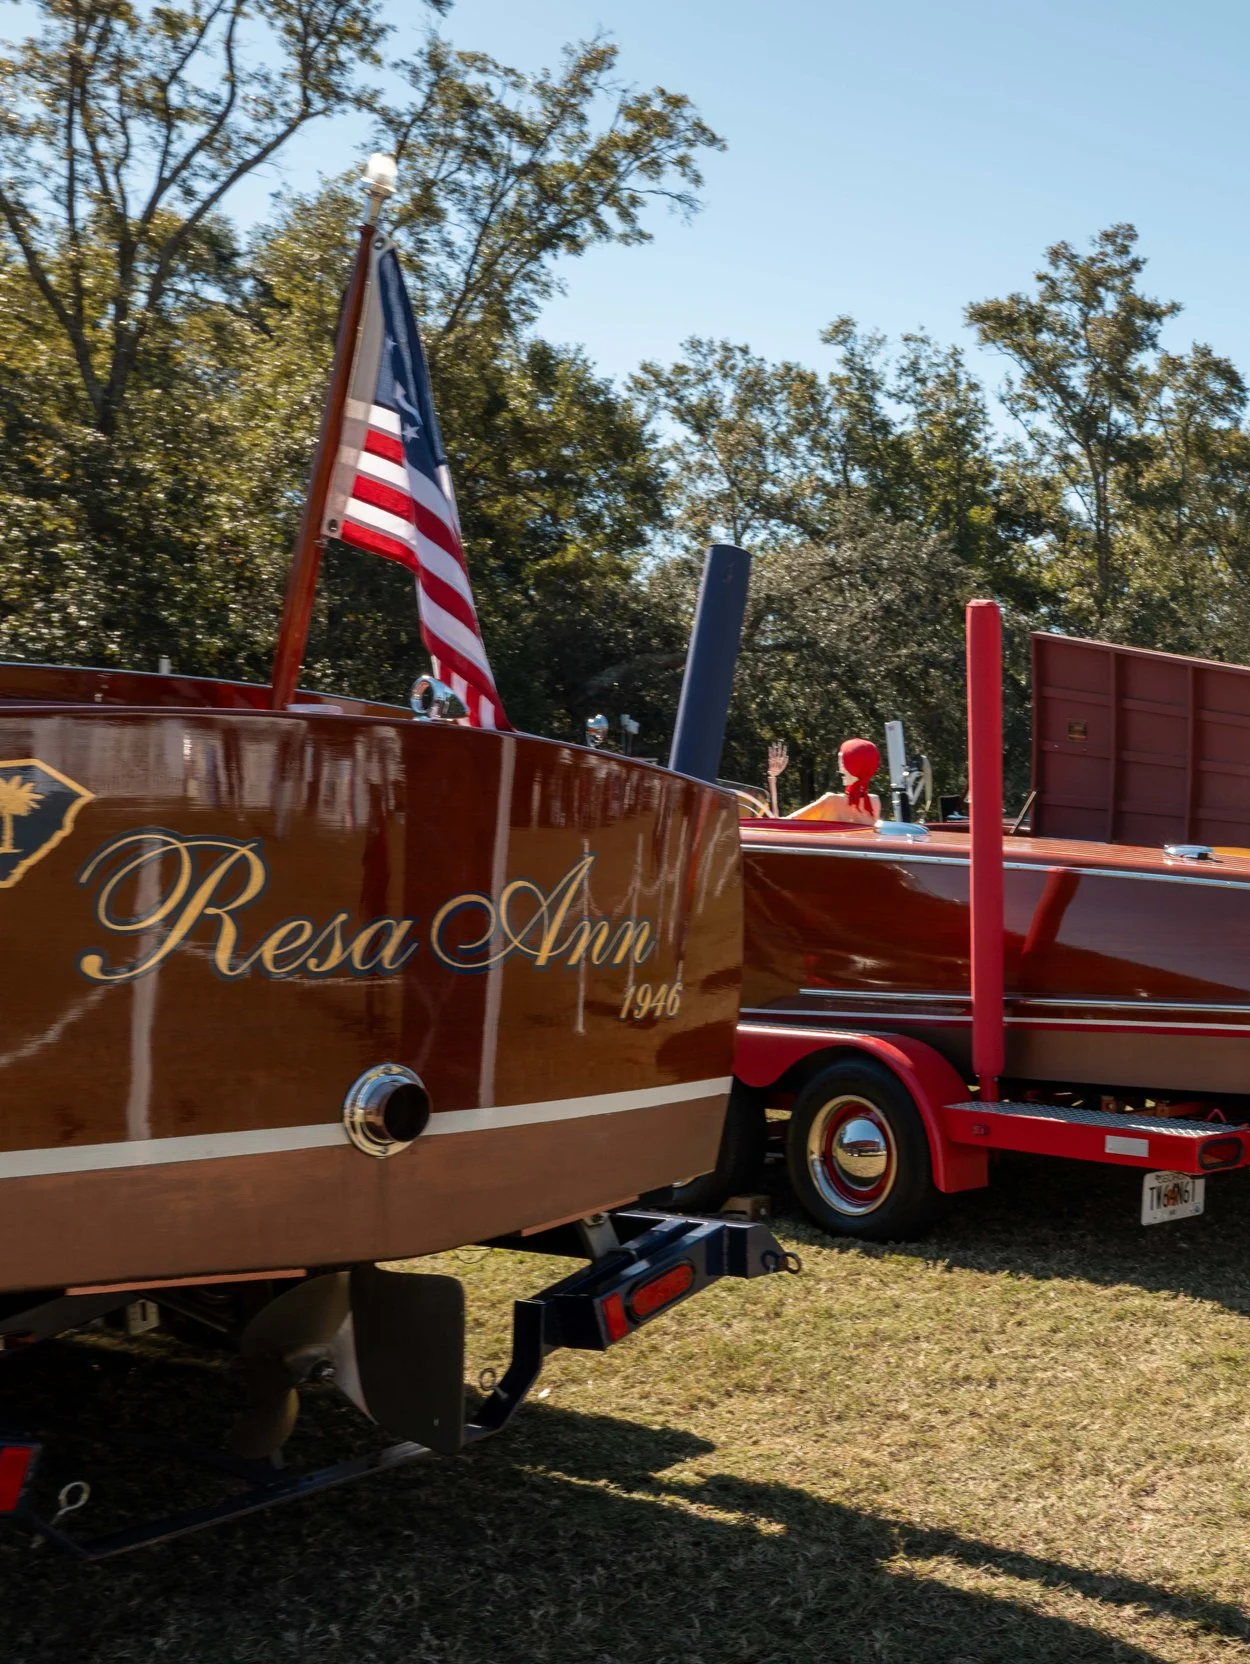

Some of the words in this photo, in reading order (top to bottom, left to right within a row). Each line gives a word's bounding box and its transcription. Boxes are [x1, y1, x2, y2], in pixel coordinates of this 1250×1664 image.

[77, 830, 419, 981] Resa
[427, 853, 658, 972] Ann
[618, 981, 682, 1020] 1946
